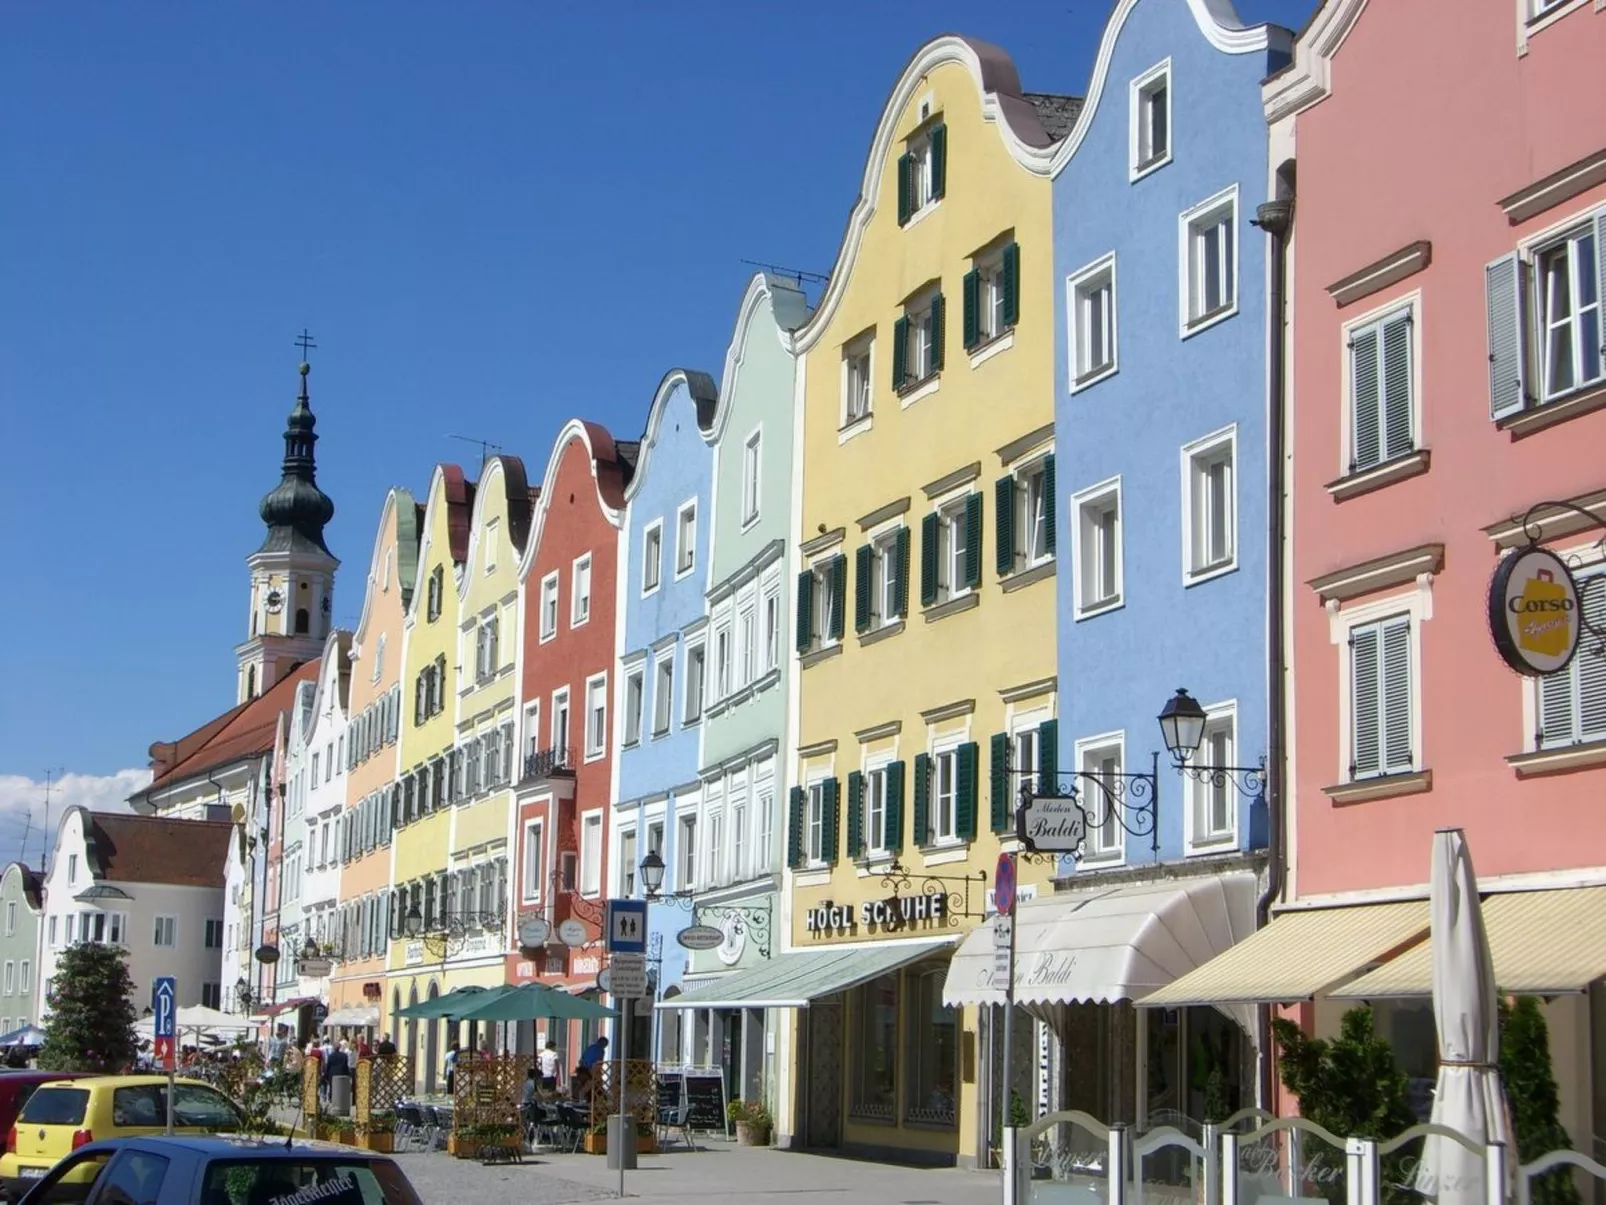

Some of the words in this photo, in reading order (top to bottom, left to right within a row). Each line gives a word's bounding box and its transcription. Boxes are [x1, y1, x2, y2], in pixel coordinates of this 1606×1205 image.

[1508, 596, 1574, 613] Corso
[1030, 817, 1080, 837] Baldi
[806, 901, 852, 930] HÖGL
[1028, 953, 1076, 986] Baldi
[159, 994, 171, 1034] P
